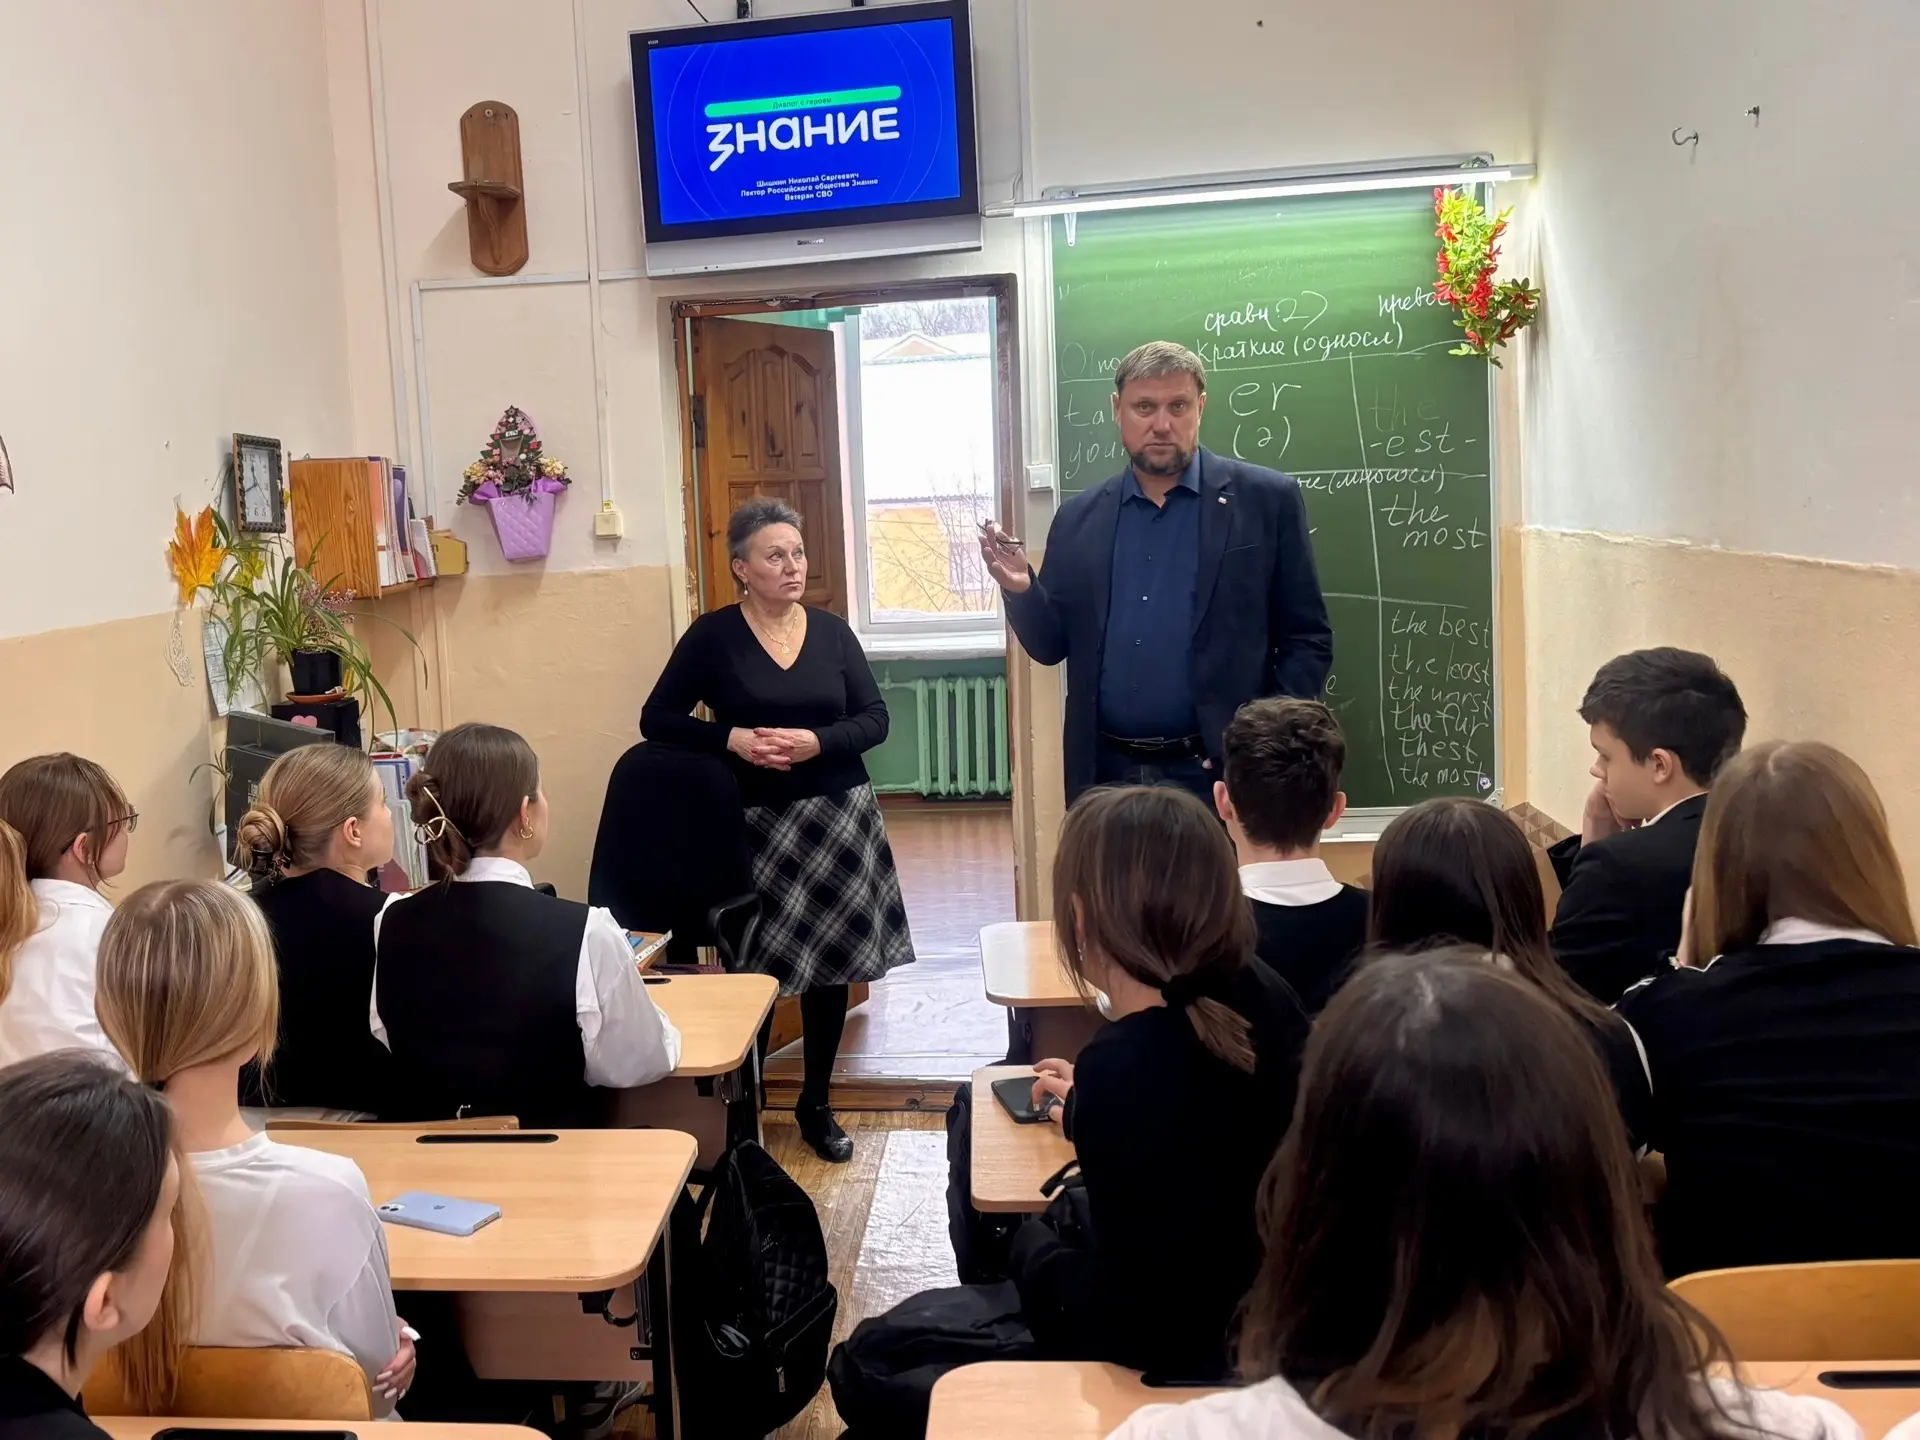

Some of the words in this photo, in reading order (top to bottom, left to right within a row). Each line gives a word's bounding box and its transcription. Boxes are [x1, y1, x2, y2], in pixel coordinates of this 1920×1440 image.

[741, 189, 766, 197] Лектор
[767, 184, 813, 194] Российского
[815, 181, 850, 190] общества
[851, 178, 879, 187] Знание
[788, 175, 820, 184] Николай
[820, 172, 859, 182] Сергеевич
[784, 193, 814, 201] Ветеран
[815, 189, 833, 198] СВО
[1380, 490, 1449, 526] the
[1402, 517, 1487, 549] most
[1391, 609, 1429, 635] the
[1438, 605, 1490, 648] best
[1388, 675, 1423, 702] the
[1390, 700, 1435, 734] the
[1399, 757, 1429, 788] the
